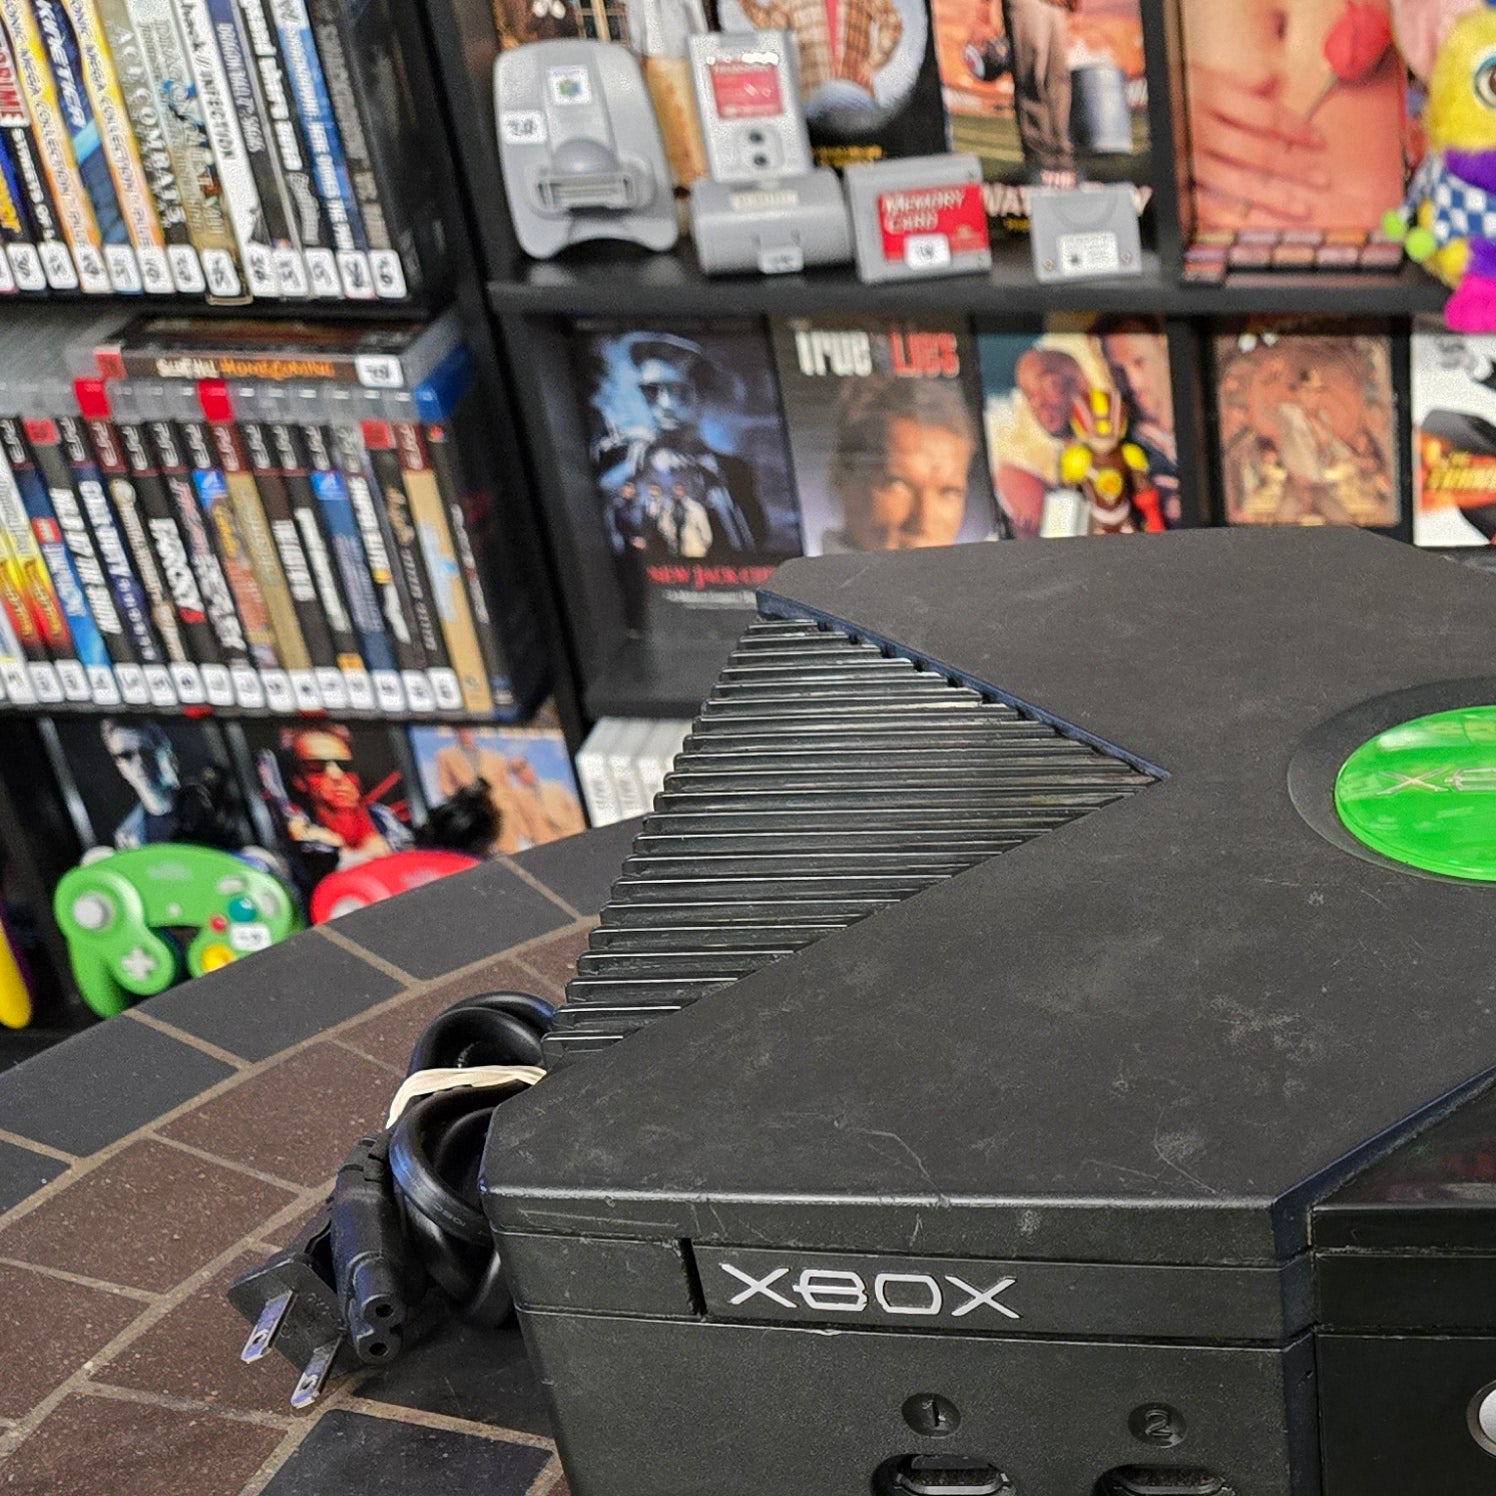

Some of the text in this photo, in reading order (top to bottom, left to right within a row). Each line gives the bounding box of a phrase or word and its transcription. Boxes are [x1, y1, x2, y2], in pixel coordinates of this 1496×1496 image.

[130, 88, 179, 200] COMBAT
[717, 1262, 1021, 1320] XBOX
[1144, 1409, 1174, 1439] 2
